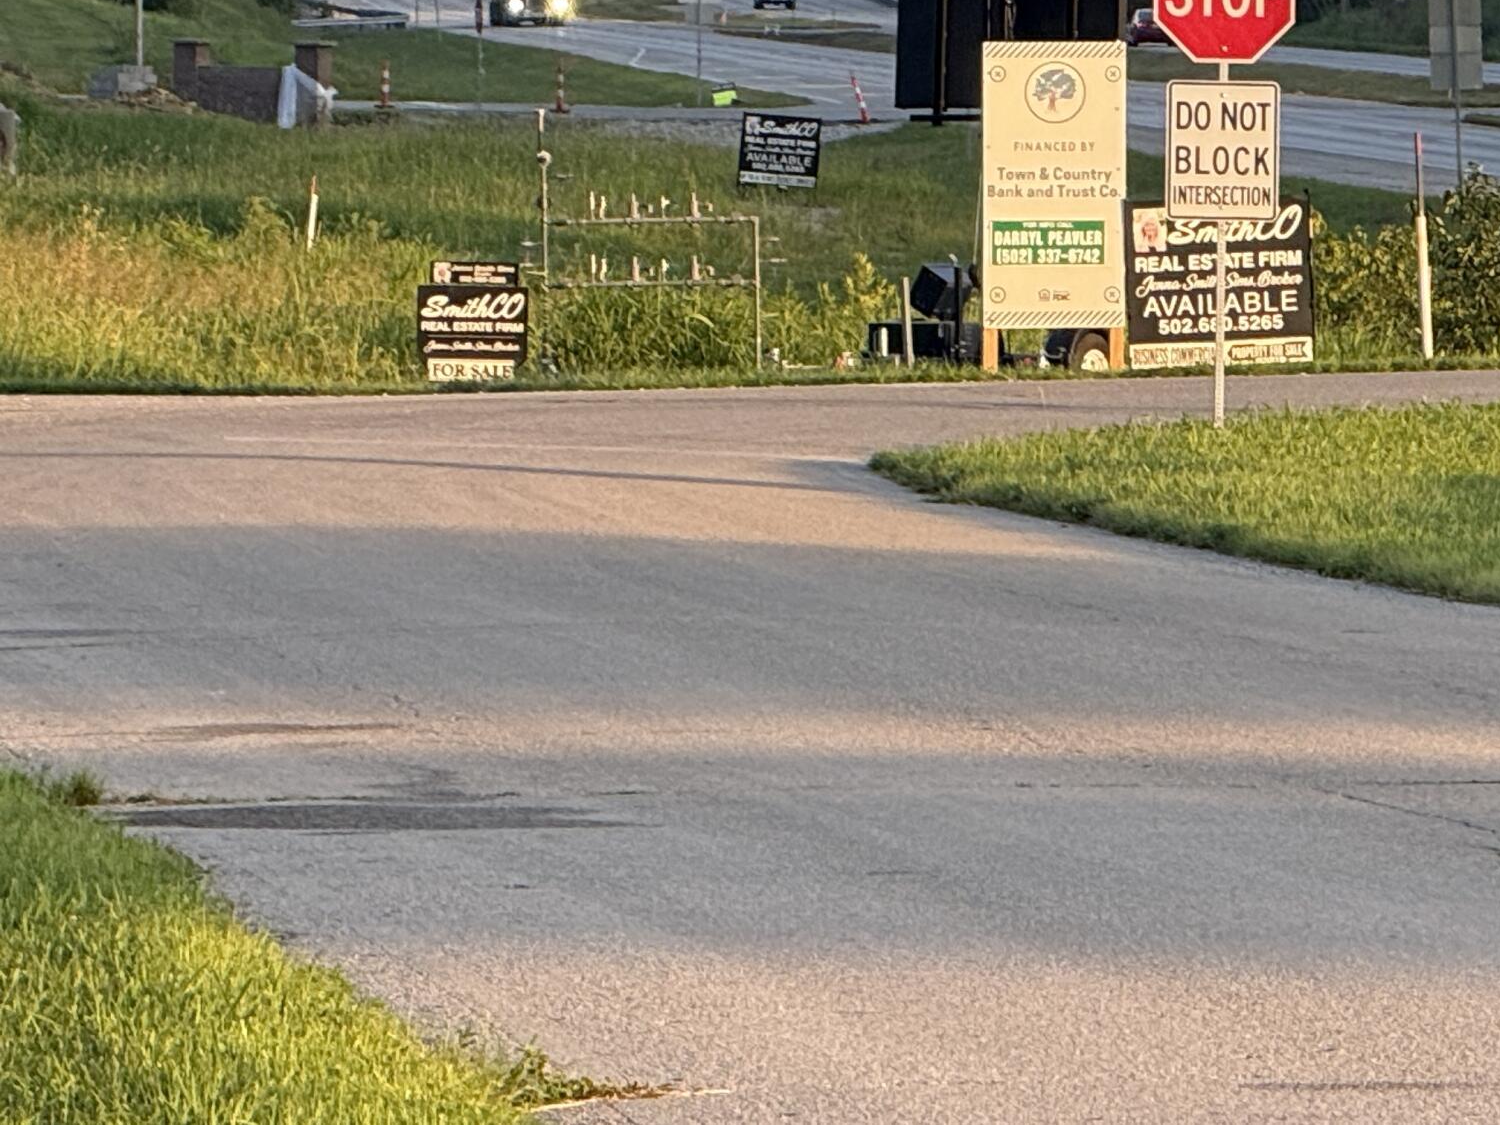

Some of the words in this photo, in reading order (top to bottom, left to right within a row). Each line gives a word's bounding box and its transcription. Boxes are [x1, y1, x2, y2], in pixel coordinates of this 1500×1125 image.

[1176, 101, 1211, 131] DO
[1221, 102, 1271, 132] NOT
[1013, 141, 1076, 152] FINANCED
[1080, 141, 1096, 152] BY
[746, 152, 812, 167] AVAILABLE
[1175, 145, 1270, 176] BLOCK
[997, 167, 1036, 181] Town
[1039, 167, 1050, 180] &
[1053, 167, 1113, 183] Country
[987, 185, 1023, 198] Bank
[1026, 185, 1053, 198] and
[1056, 185, 1097, 198] Trust
[1099, 185, 1121, 198] Co.
[1172, 185, 1271, 207] INTERSECTION
[994, 230, 1043, 246] DARRYL
[1047, 230, 1103, 246] PEAVLER
[996, 248, 1033, 264] (502)
[1135, 255, 1185, 273] REAL
[1258, 250, 1303, 267] FIRM
[421, 293, 525, 318] SmithCO
[1143, 290, 1299, 318] AVAILABLE
[421, 321, 451, 331] REAL
[1158, 314, 1285, 335] 502.680.5265
[433, 363, 465, 377] FOR
[471, 365, 512, 379] SALE
